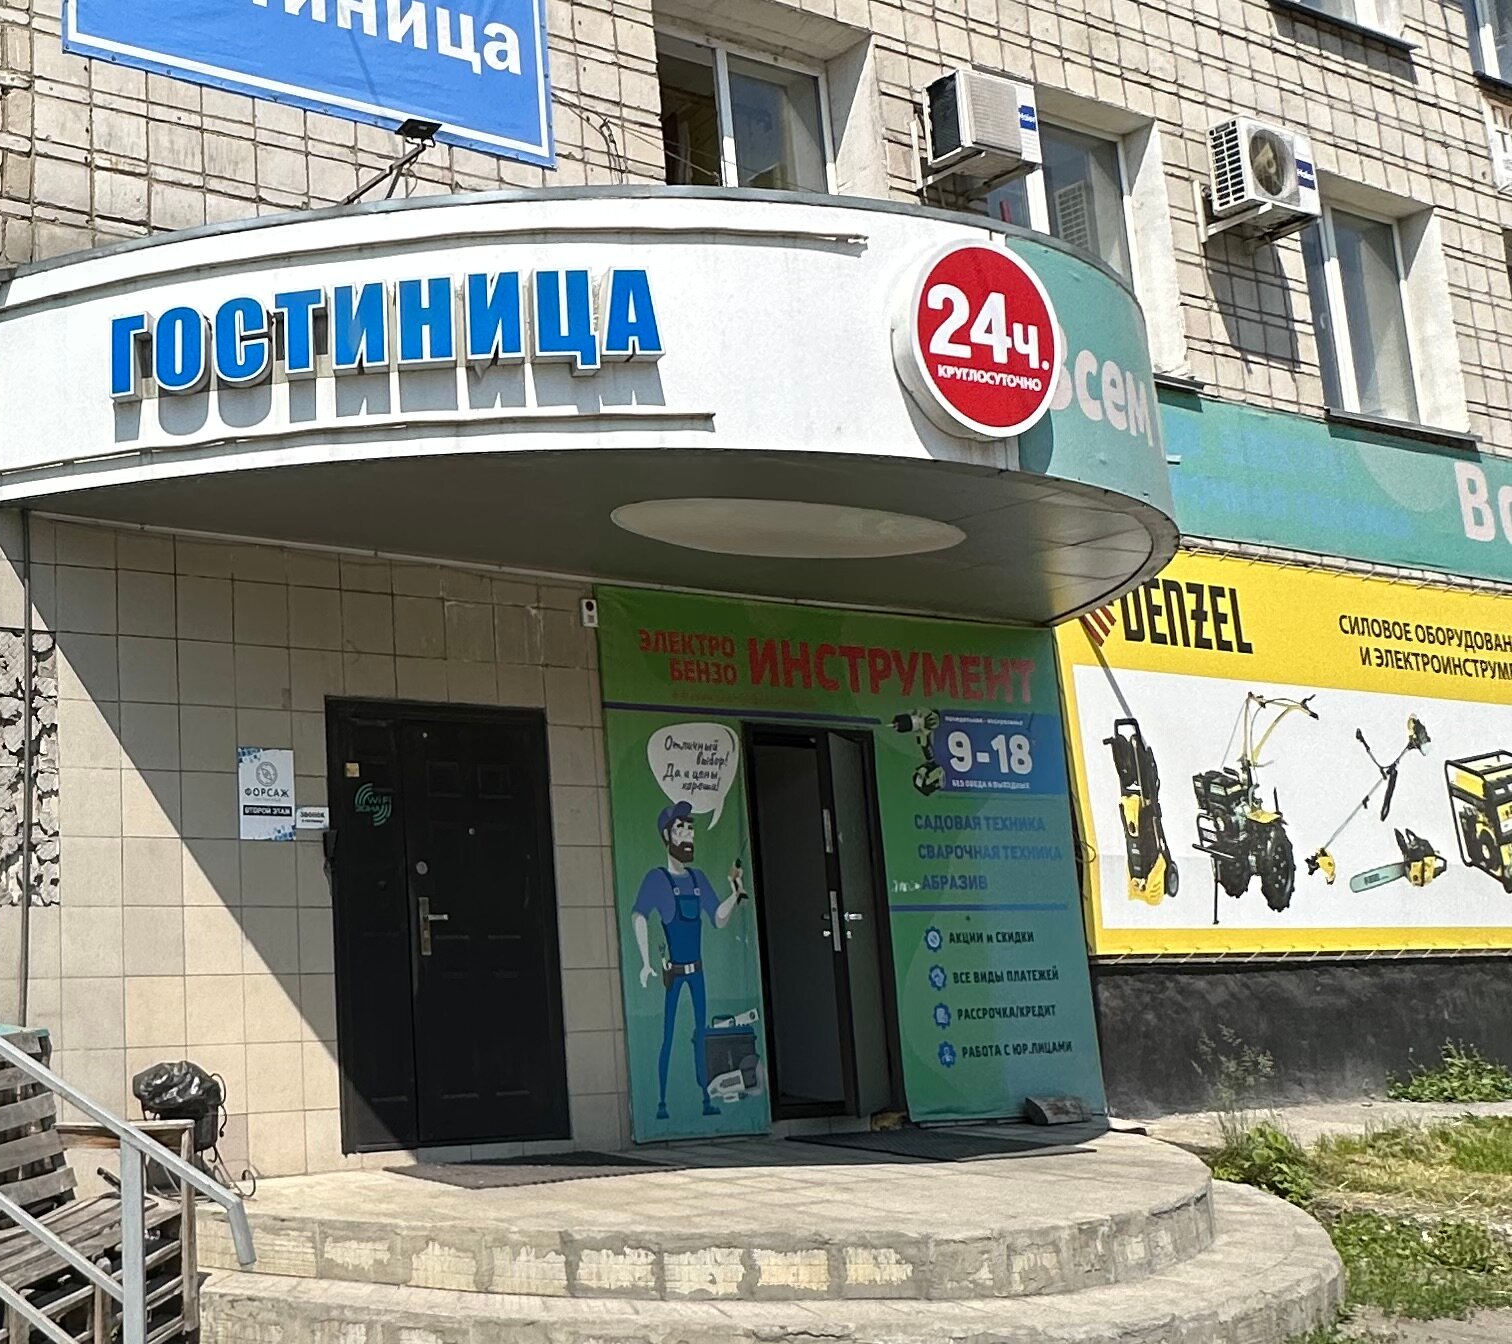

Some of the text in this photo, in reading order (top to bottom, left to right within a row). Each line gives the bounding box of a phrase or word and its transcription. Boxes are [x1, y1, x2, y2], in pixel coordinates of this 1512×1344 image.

[110, 267, 664, 400] ГОСТИНИЦА
[937, 364, 1042, 391] КРУГЛОСУТОЧНО
[1120, 577, 1254, 654] DENZEL
[1339, 614, 1413, 642] СИЛОВОЕ
[638, 628, 736, 658] ЭЛЕКТРО
[1360, 646, 1372, 666] И
[669, 659, 737, 686] БЕНЗО
[747, 637, 1036, 704] ИНСТРУМЕНТ
[947, 731, 1033, 775] 9-18
[662, 763, 681, 782] Да
[244, 787, 290, 798] ФОРСАЖ
[914, 814, 1046, 832] САДОВАЯ ТЕХНИКА
[918, 844, 1063, 860] СВАРОЧНАЯ ТЕХНИКА
[922, 874, 988, 891] АБРАЗИВ
[949, 931, 984, 945] АКЦИИ
[995, 931, 1034, 944] СКИДКИ
[953, 966, 1059, 984] ВСЕ ВИДЫ ПЛАТЕЖЕЙ
[957, 1004, 1056, 1021] РАССРОЧКА/КРЕДИТ
[961, 1044, 1002, 1058] РАБОТА
[1003, 1043, 1011, 1056] С
